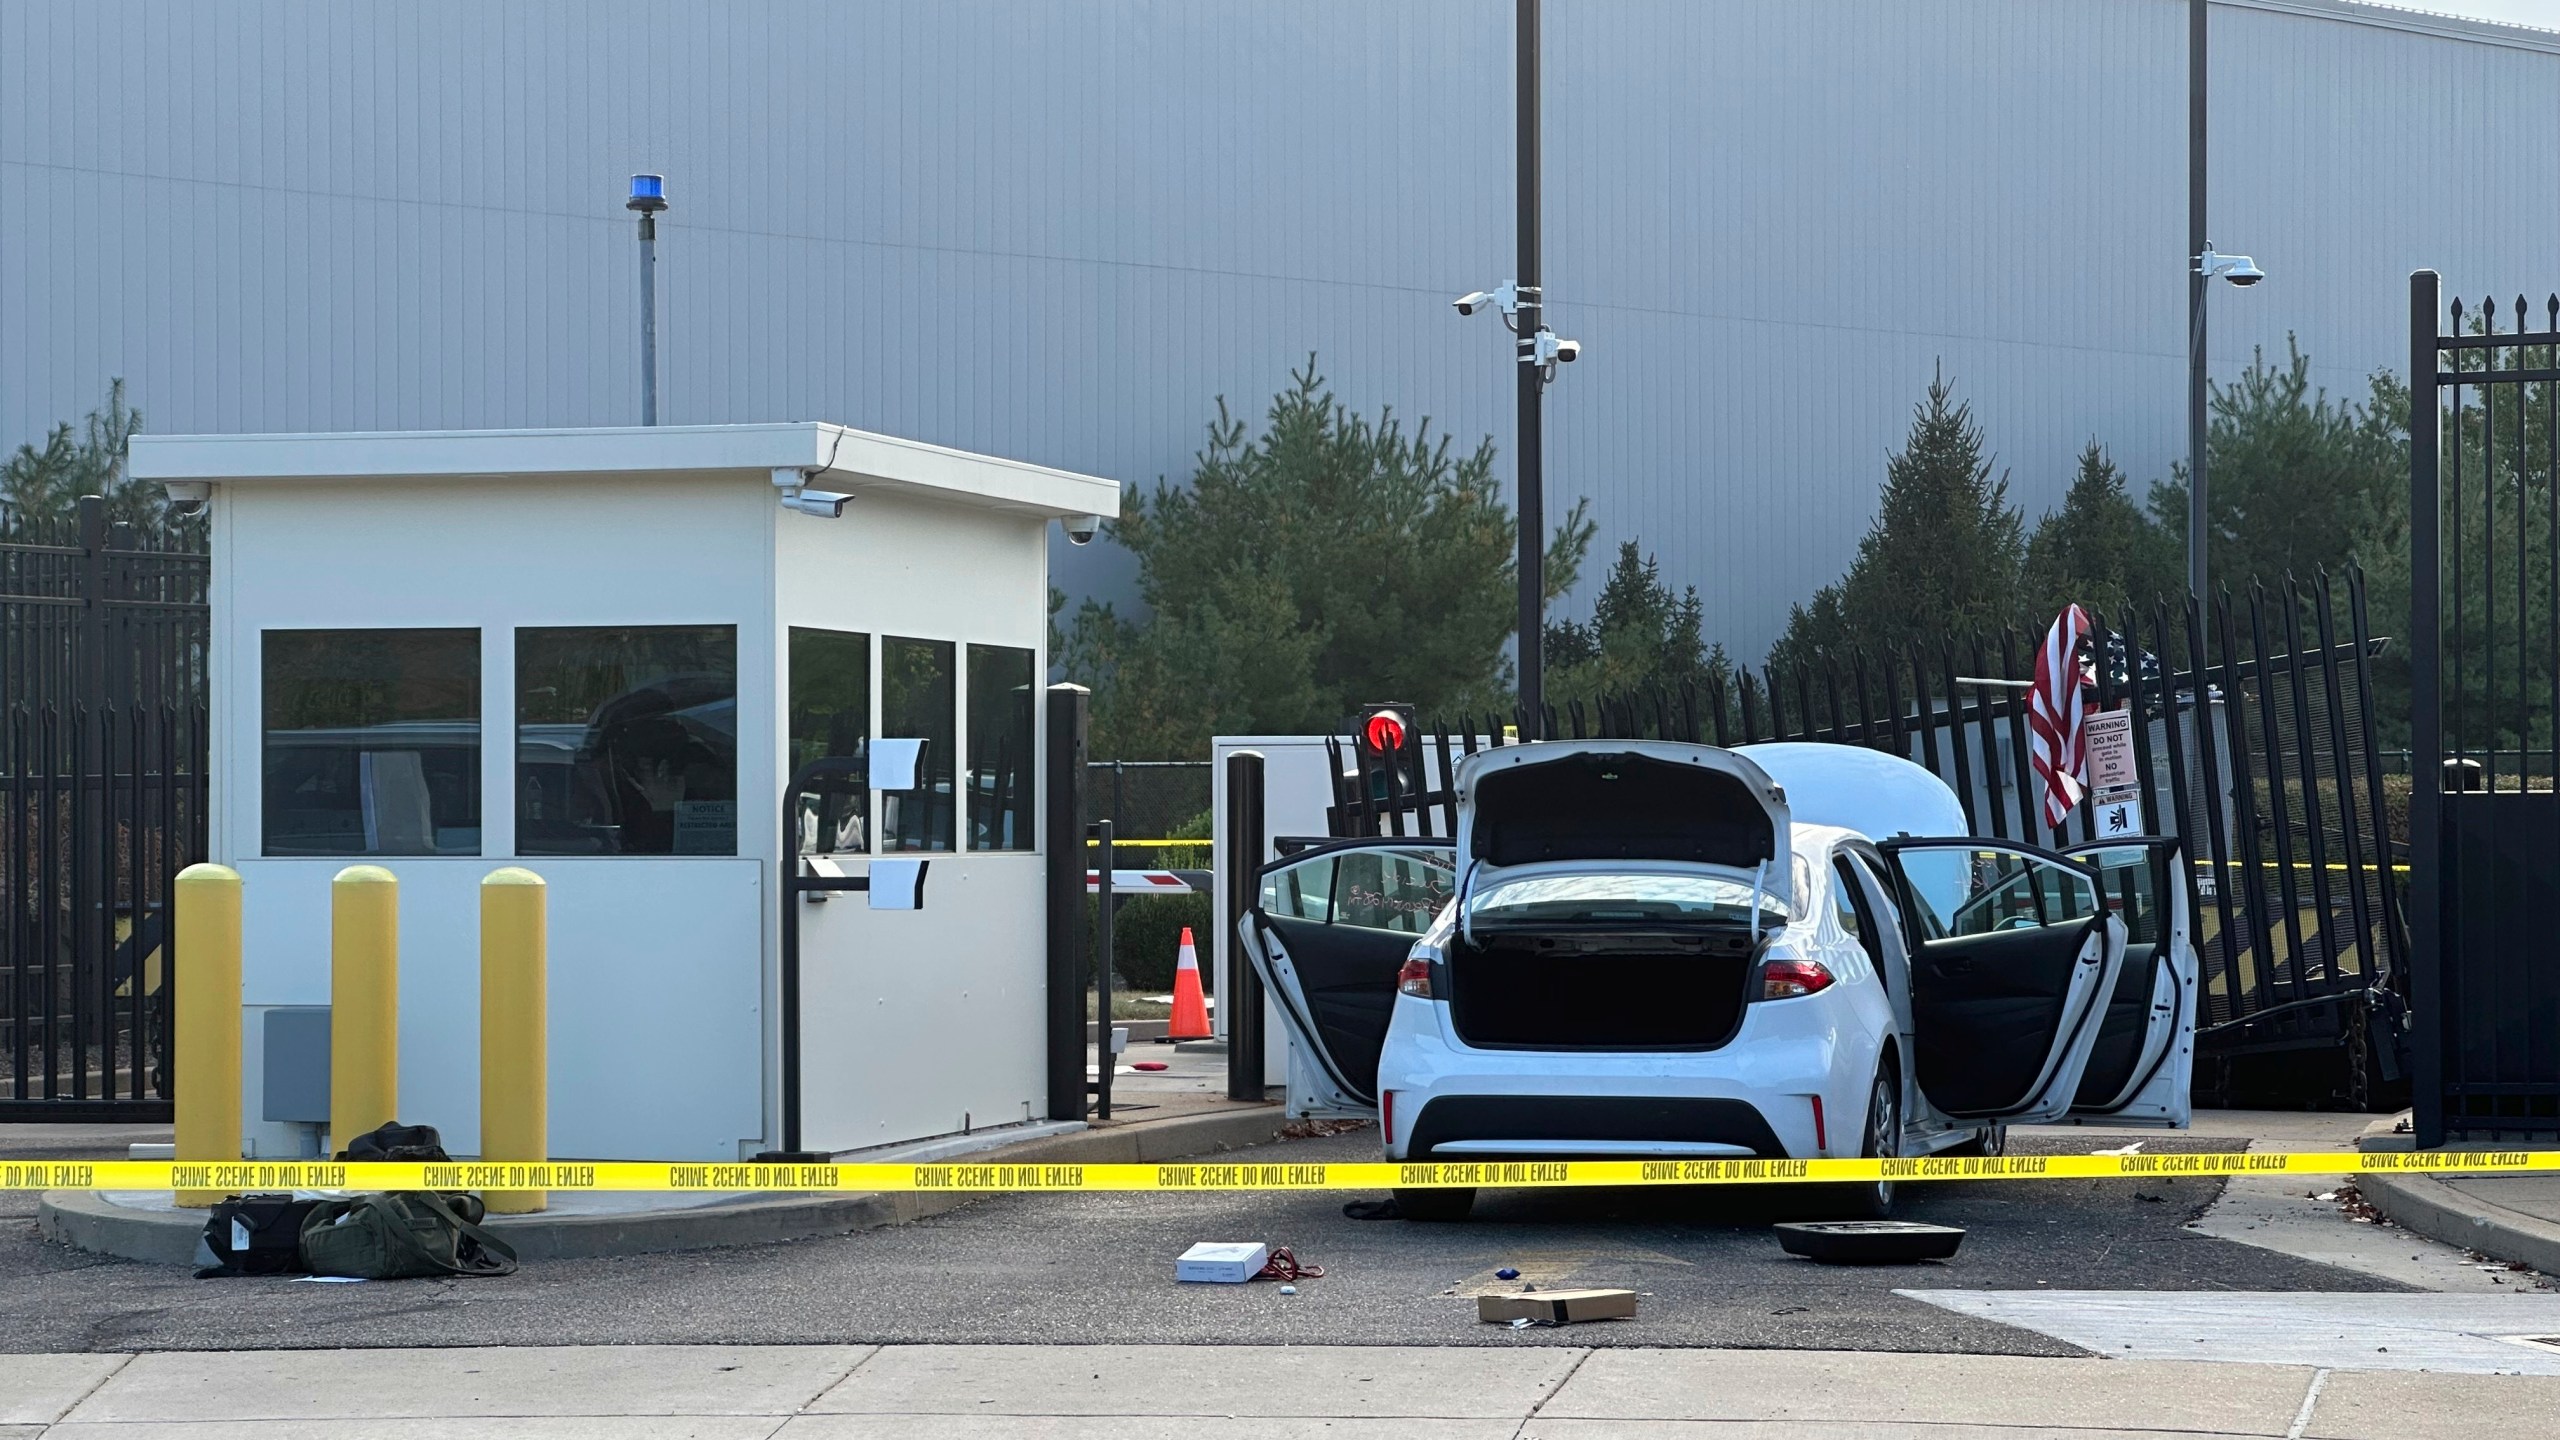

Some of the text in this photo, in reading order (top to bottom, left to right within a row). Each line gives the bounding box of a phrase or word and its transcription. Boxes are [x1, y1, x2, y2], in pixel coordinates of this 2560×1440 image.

[2088, 720, 2127, 733] WARNING
[2093, 734, 2123, 745] DO NOT
[2105, 762, 2117, 770] NO
[2106, 792, 2133, 803] WARNING
[692, 805, 725, 813] NOTICE
